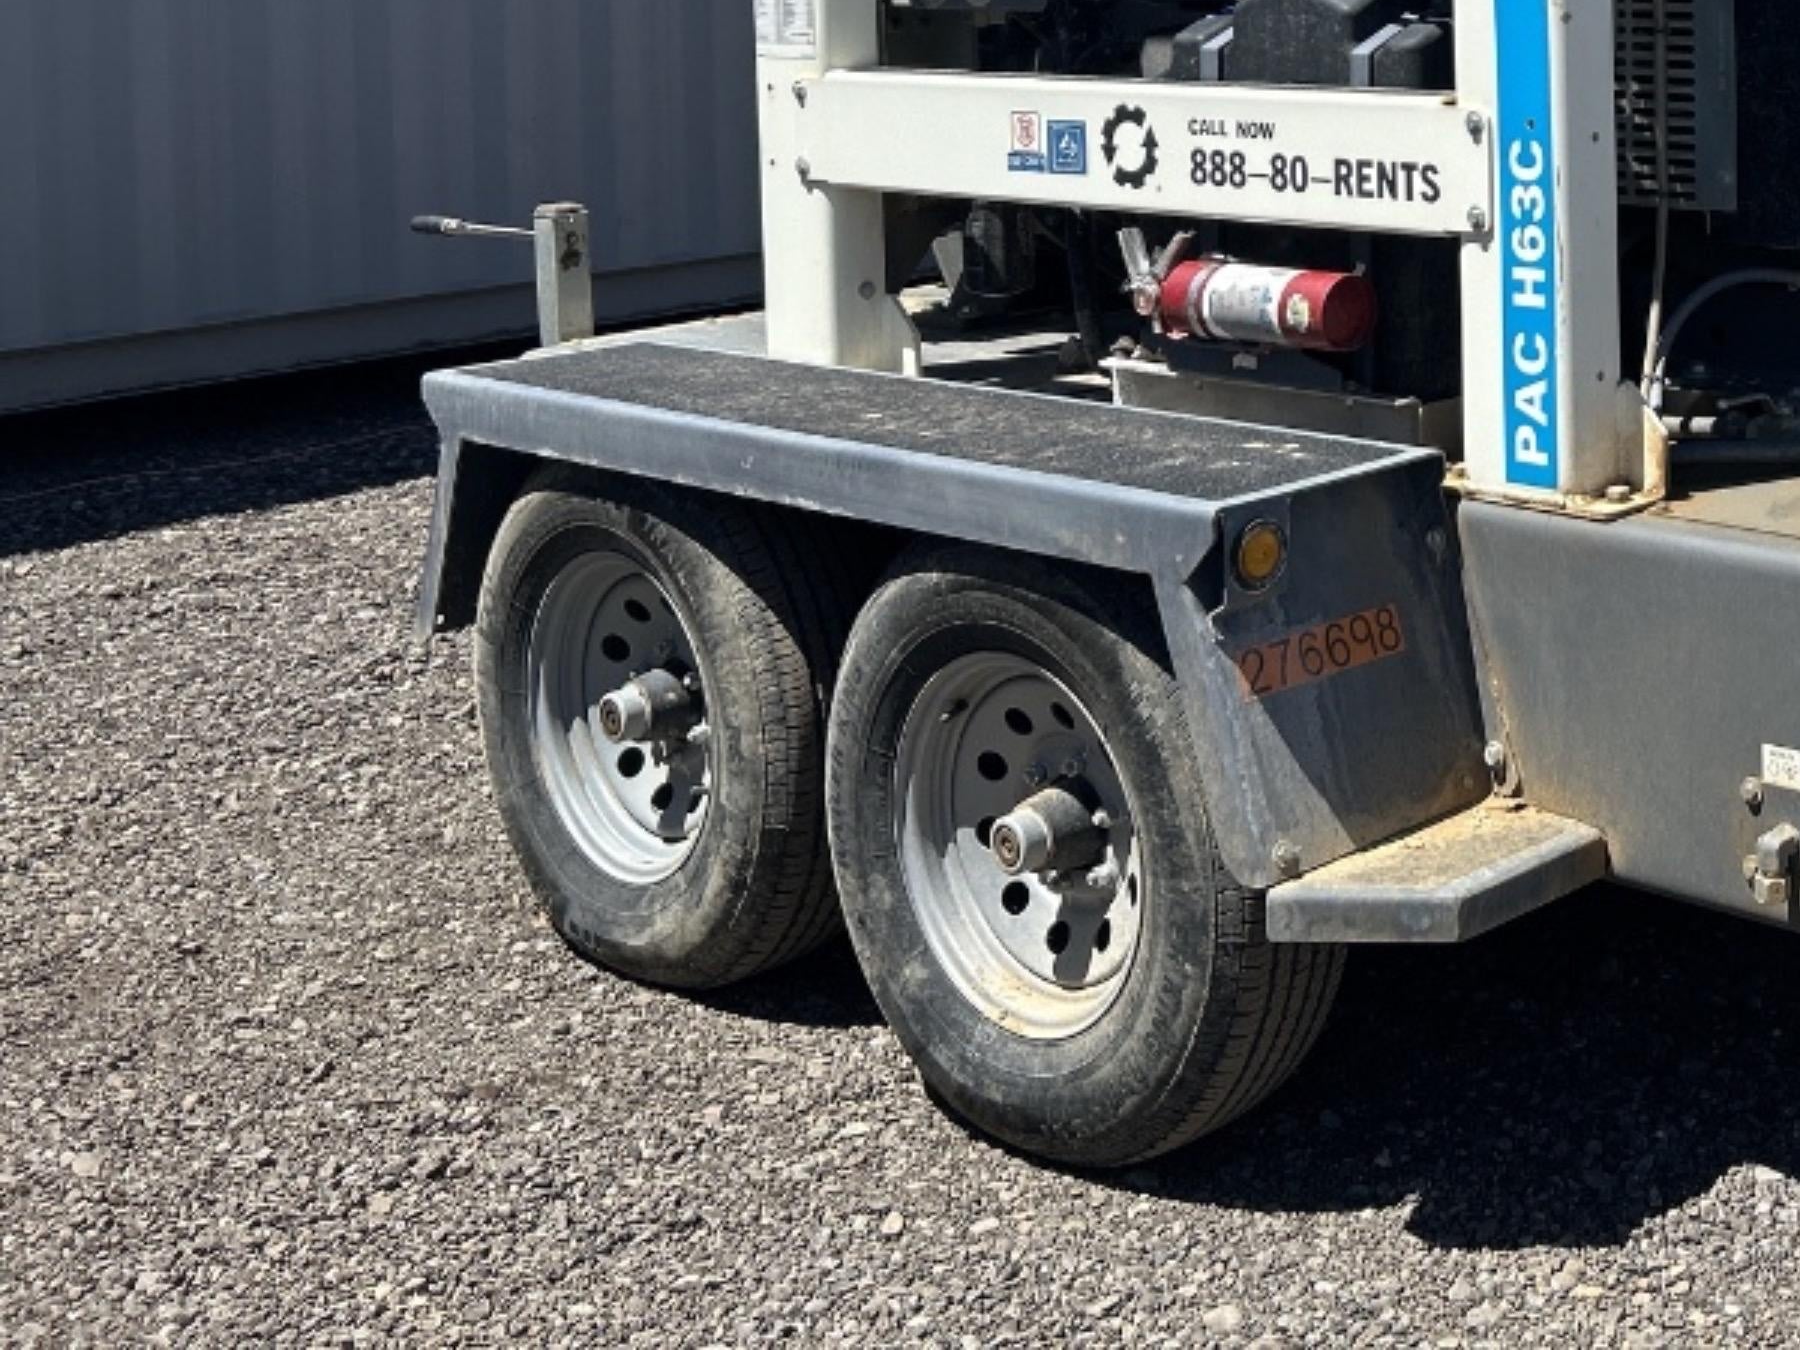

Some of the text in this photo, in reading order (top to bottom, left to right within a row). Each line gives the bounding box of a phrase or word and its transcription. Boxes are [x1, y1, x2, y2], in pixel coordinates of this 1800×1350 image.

[1187, 117, 1276, 141] CALL NOW
[1189, 145, 1443, 205] 888-80-RENTS
[1508, 137, 1550, 468] PAC H63C
[1240, 606, 1401, 694] 276698
